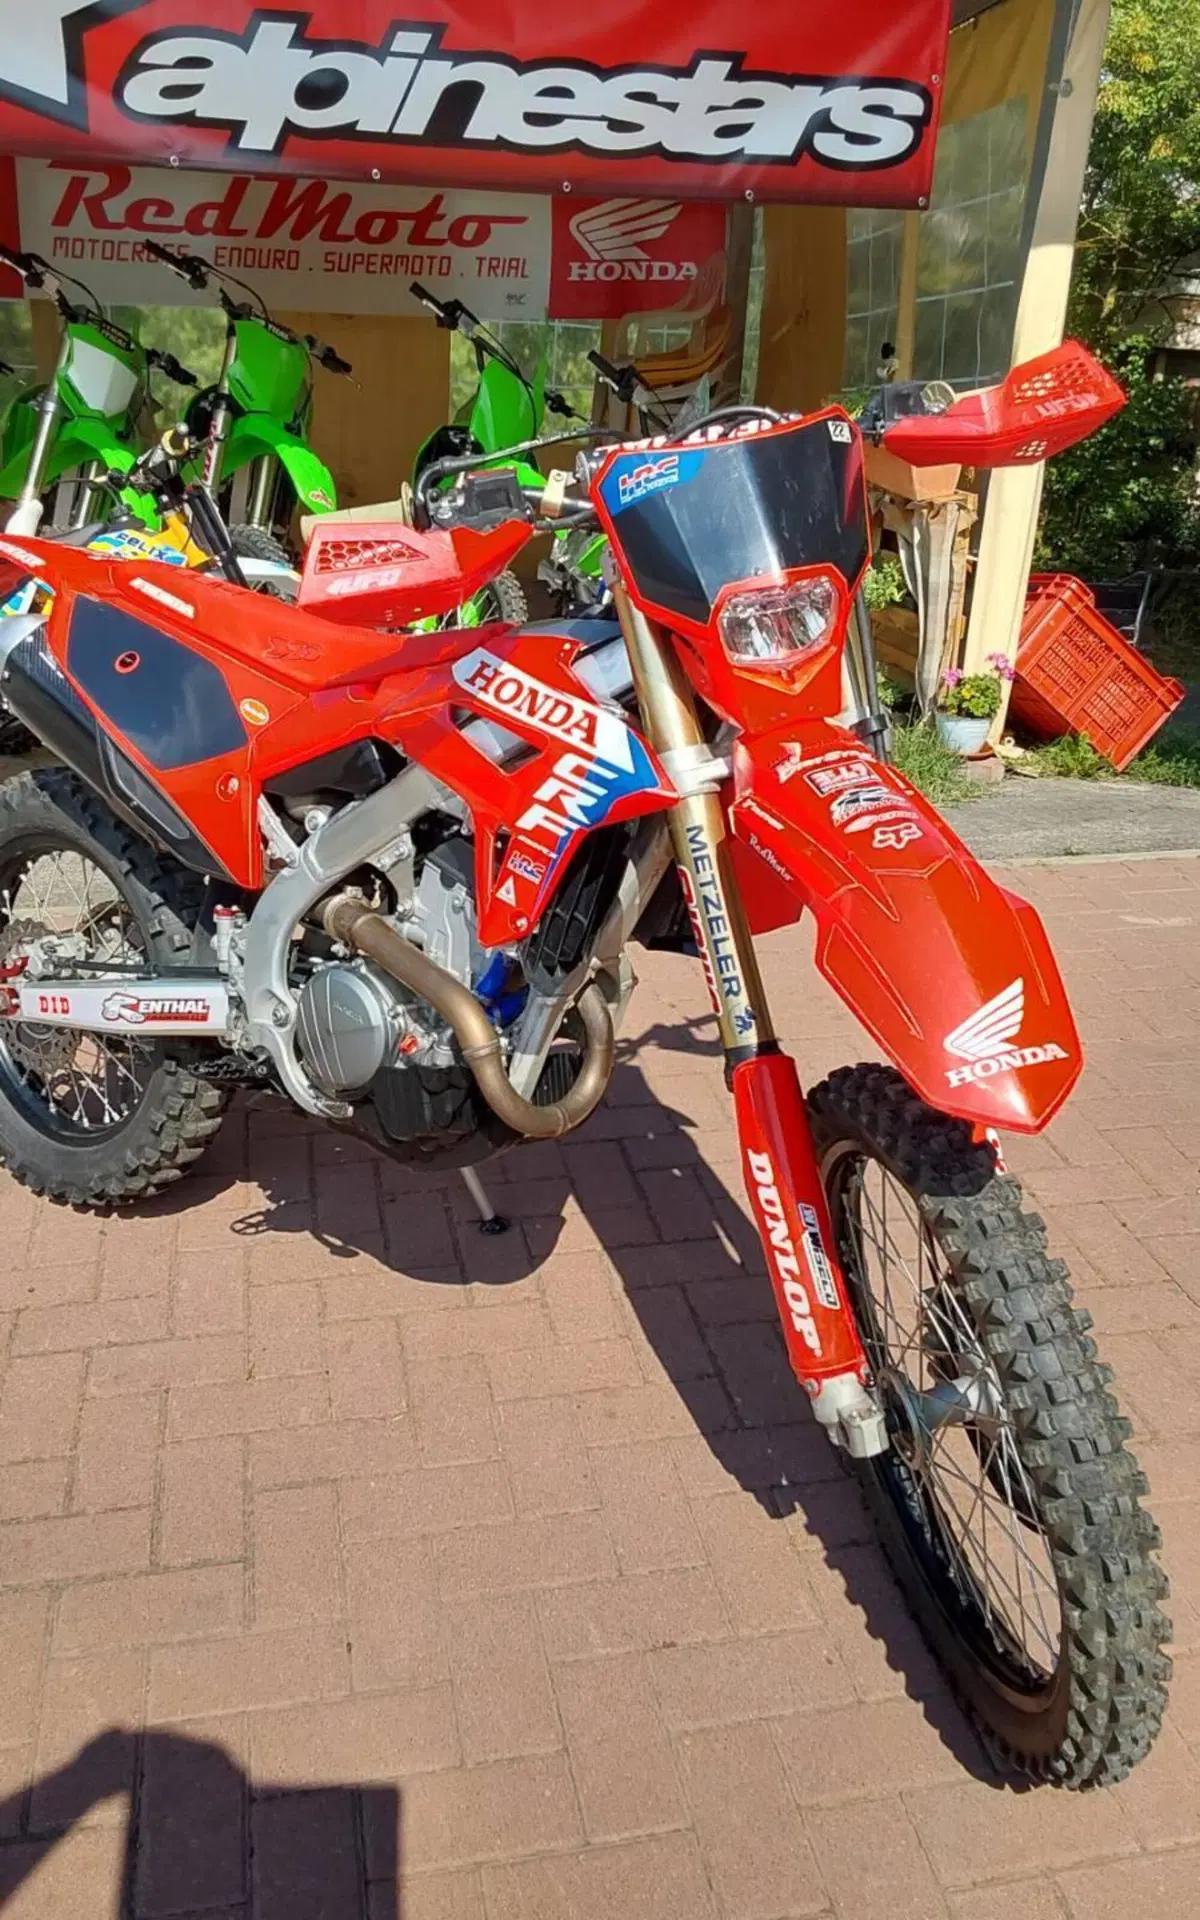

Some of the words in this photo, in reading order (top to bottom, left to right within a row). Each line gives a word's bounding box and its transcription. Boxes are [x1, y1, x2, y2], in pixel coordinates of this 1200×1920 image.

[123, 21, 925, 163] alpinestars
[48, 160, 530, 248] RedMoto
[214, 246, 300, 271] ENDURO
[324, 252, 452, 278] SUPERMOTO
[476, 256, 530, 279] TRIAL
[566, 261, 699, 282] HONDA
[464, 660, 600, 748] HONDA
[515, 752, 619, 837] CRF
[686, 824, 742, 999] METZELER
[944, 1042, 1069, 1088] HONDA
[747, 1148, 823, 1358] DUNLOP
